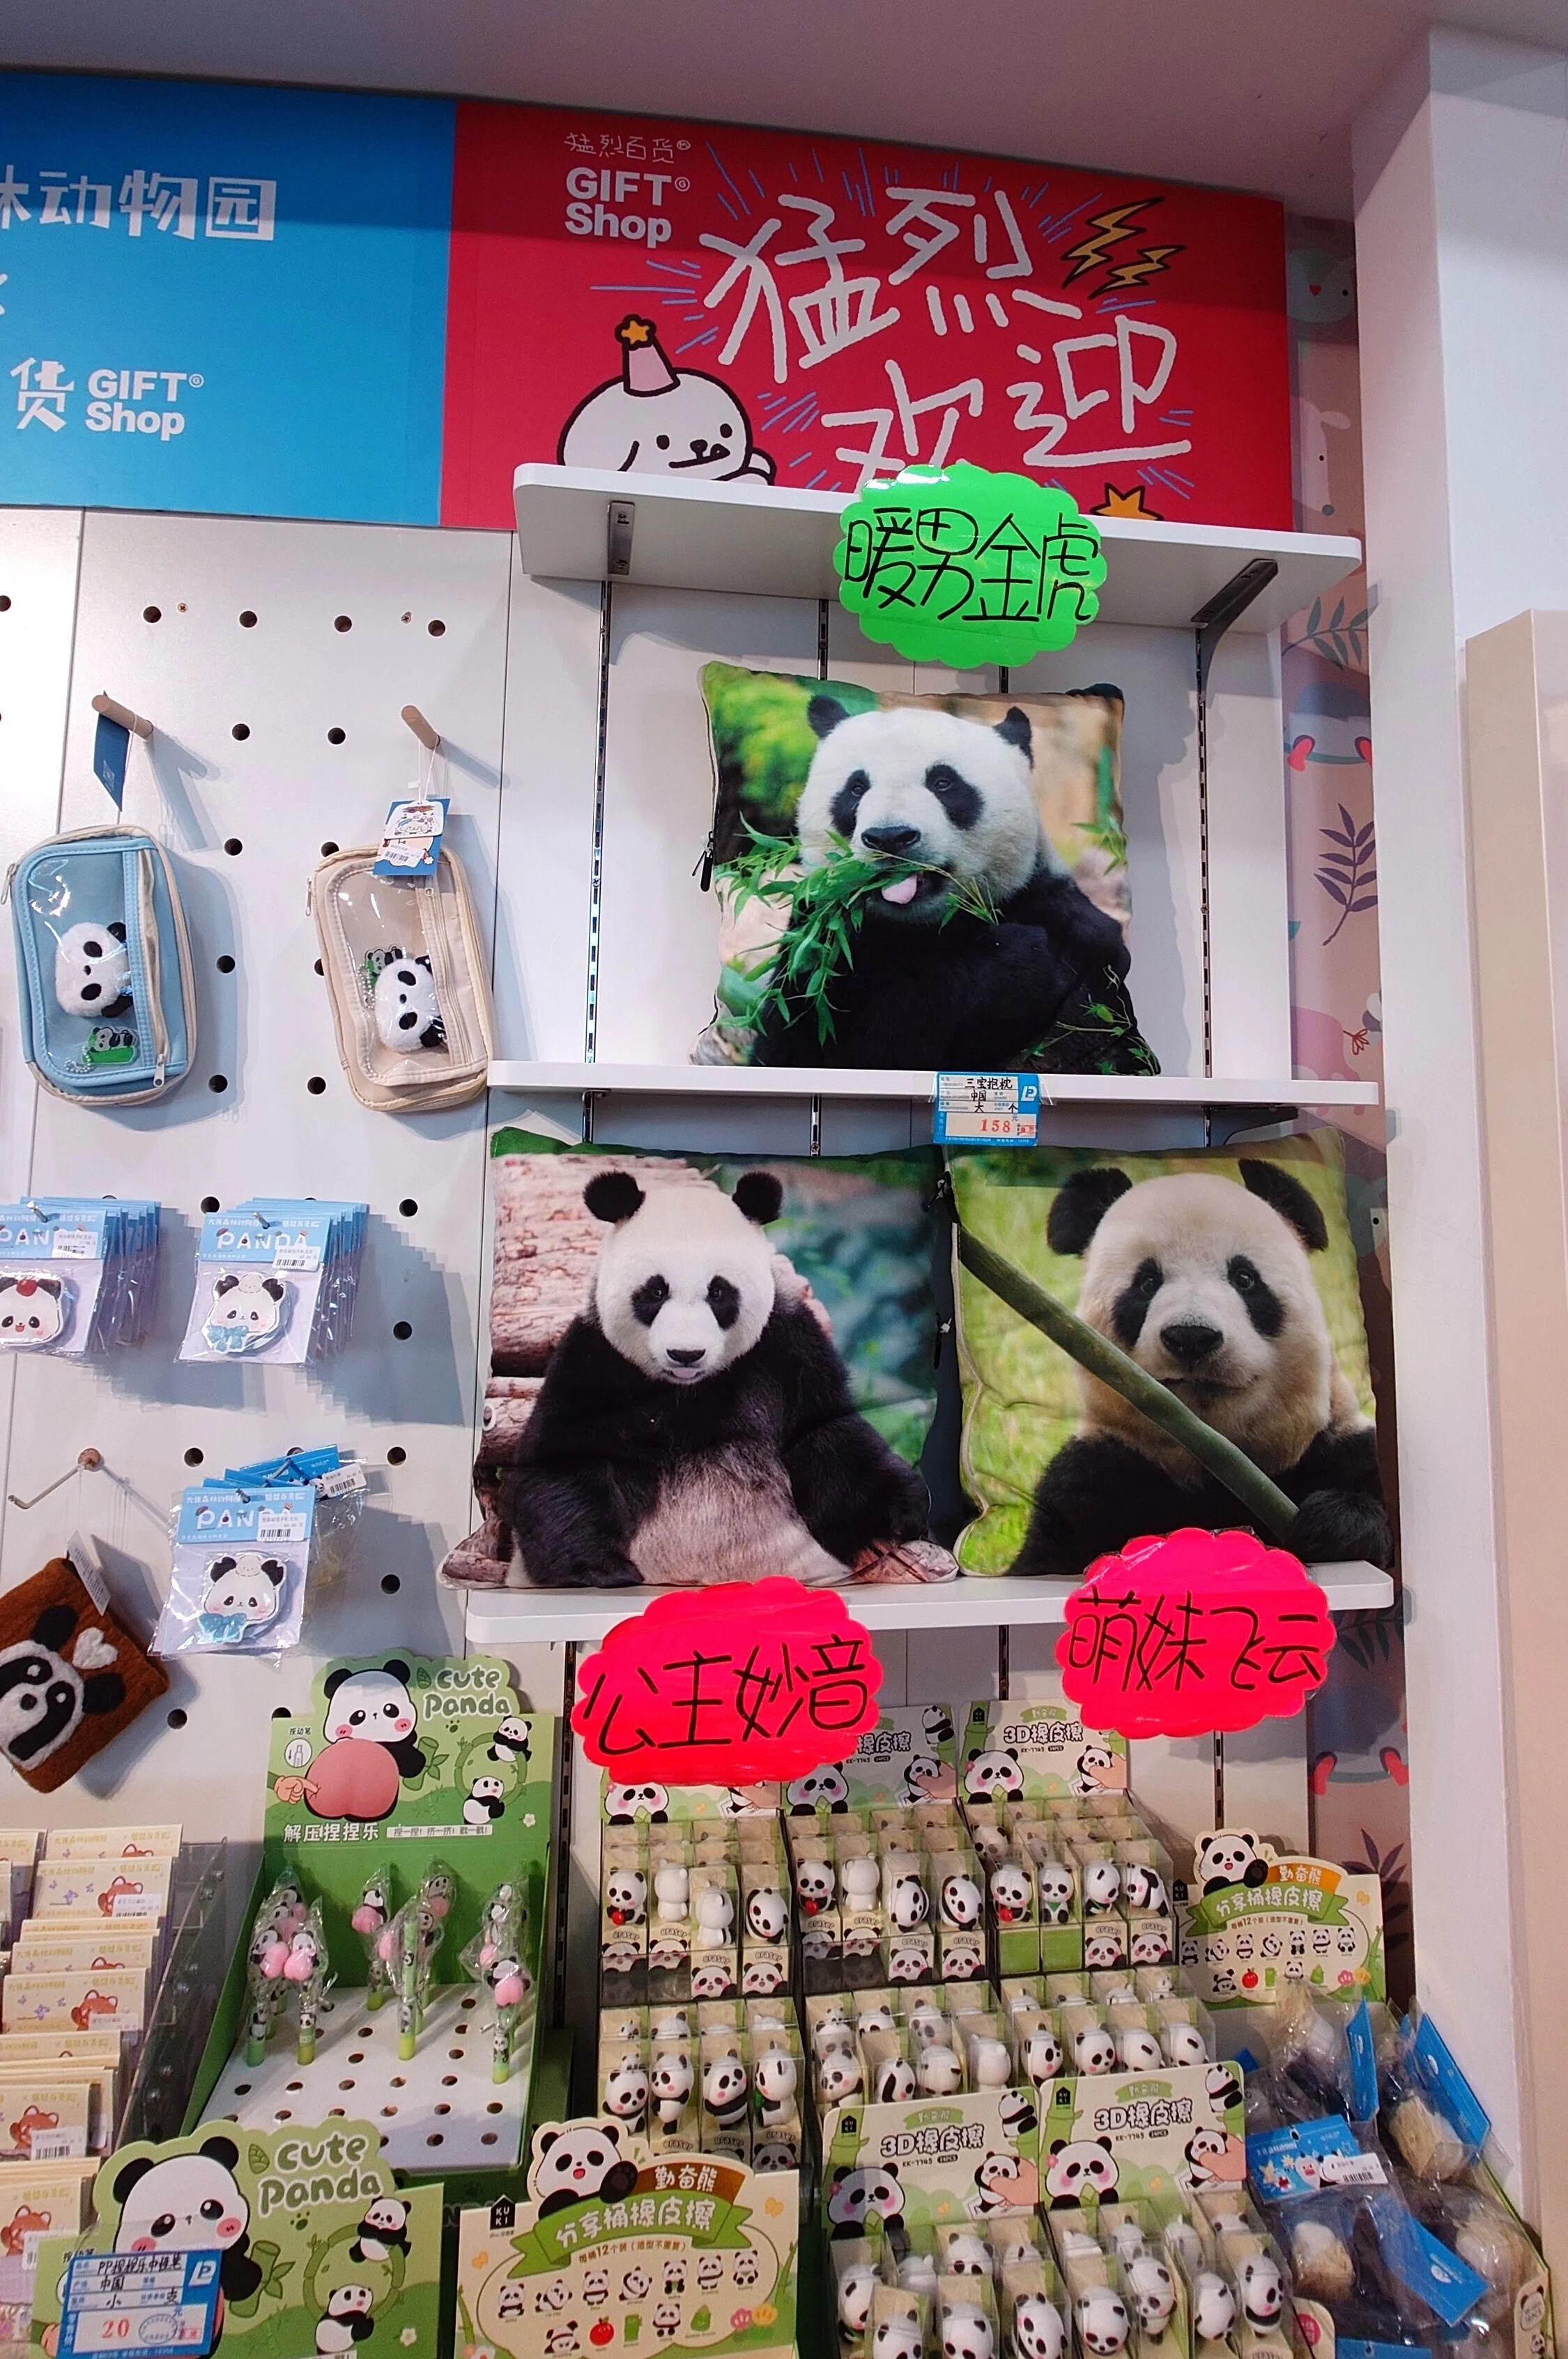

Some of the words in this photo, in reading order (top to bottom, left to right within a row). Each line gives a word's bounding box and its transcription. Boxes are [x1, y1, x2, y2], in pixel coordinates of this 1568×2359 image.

[564, 132, 675, 163] 猛烈百货
[566, 167, 672, 206] GIFT
[564, 201, 672, 249] Shop
[699, 187, 1082, 383] 猛烈
[88, 369, 187, 402] GIFT
[821, 315, 1192, 492] 欢迎
[85, 401, 185, 441] Shop
[844, 507, 1102, 623] 暖男金虎
[964, 1077, 1013, 1090] 三宝抱枕
[971, 1090, 987, 1102] 中国
[974, 1102, 985, 1113] 大
[1008, 1103, 1018, 1113] 个
[981, 1119, 1011, 1133] 158
[217, 1231, 307, 1250] PANDA
[1068, 1585, 1322, 1693] 萌妹飞云
[582, 1633, 869, 1756] 公主妙音
[289, 1727, 312, 1736] 按动笔
[1004, 1721, 1083, 1744] 3D橡皮擦
[284, 1822, 380, 1843] 解压捏捏乐
[1215, 1885, 1323, 1917] 分享桶橡皮擦
[1094, 2097, 1193, 2131] 3D橡皮擦
[275, 2131, 369, 2174] cute
[880, 2123, 985, 2158] 3D橡皮擦
[654, 2165, 718, 2192] 勤奋熊
[555, 2195, 716, 2248] 分享桶橡皮擦
[100, 2274, 125, 2291] 中国
[106, 2293, 121, 2309] 小
[102, 2318, 130, 2339] 20
